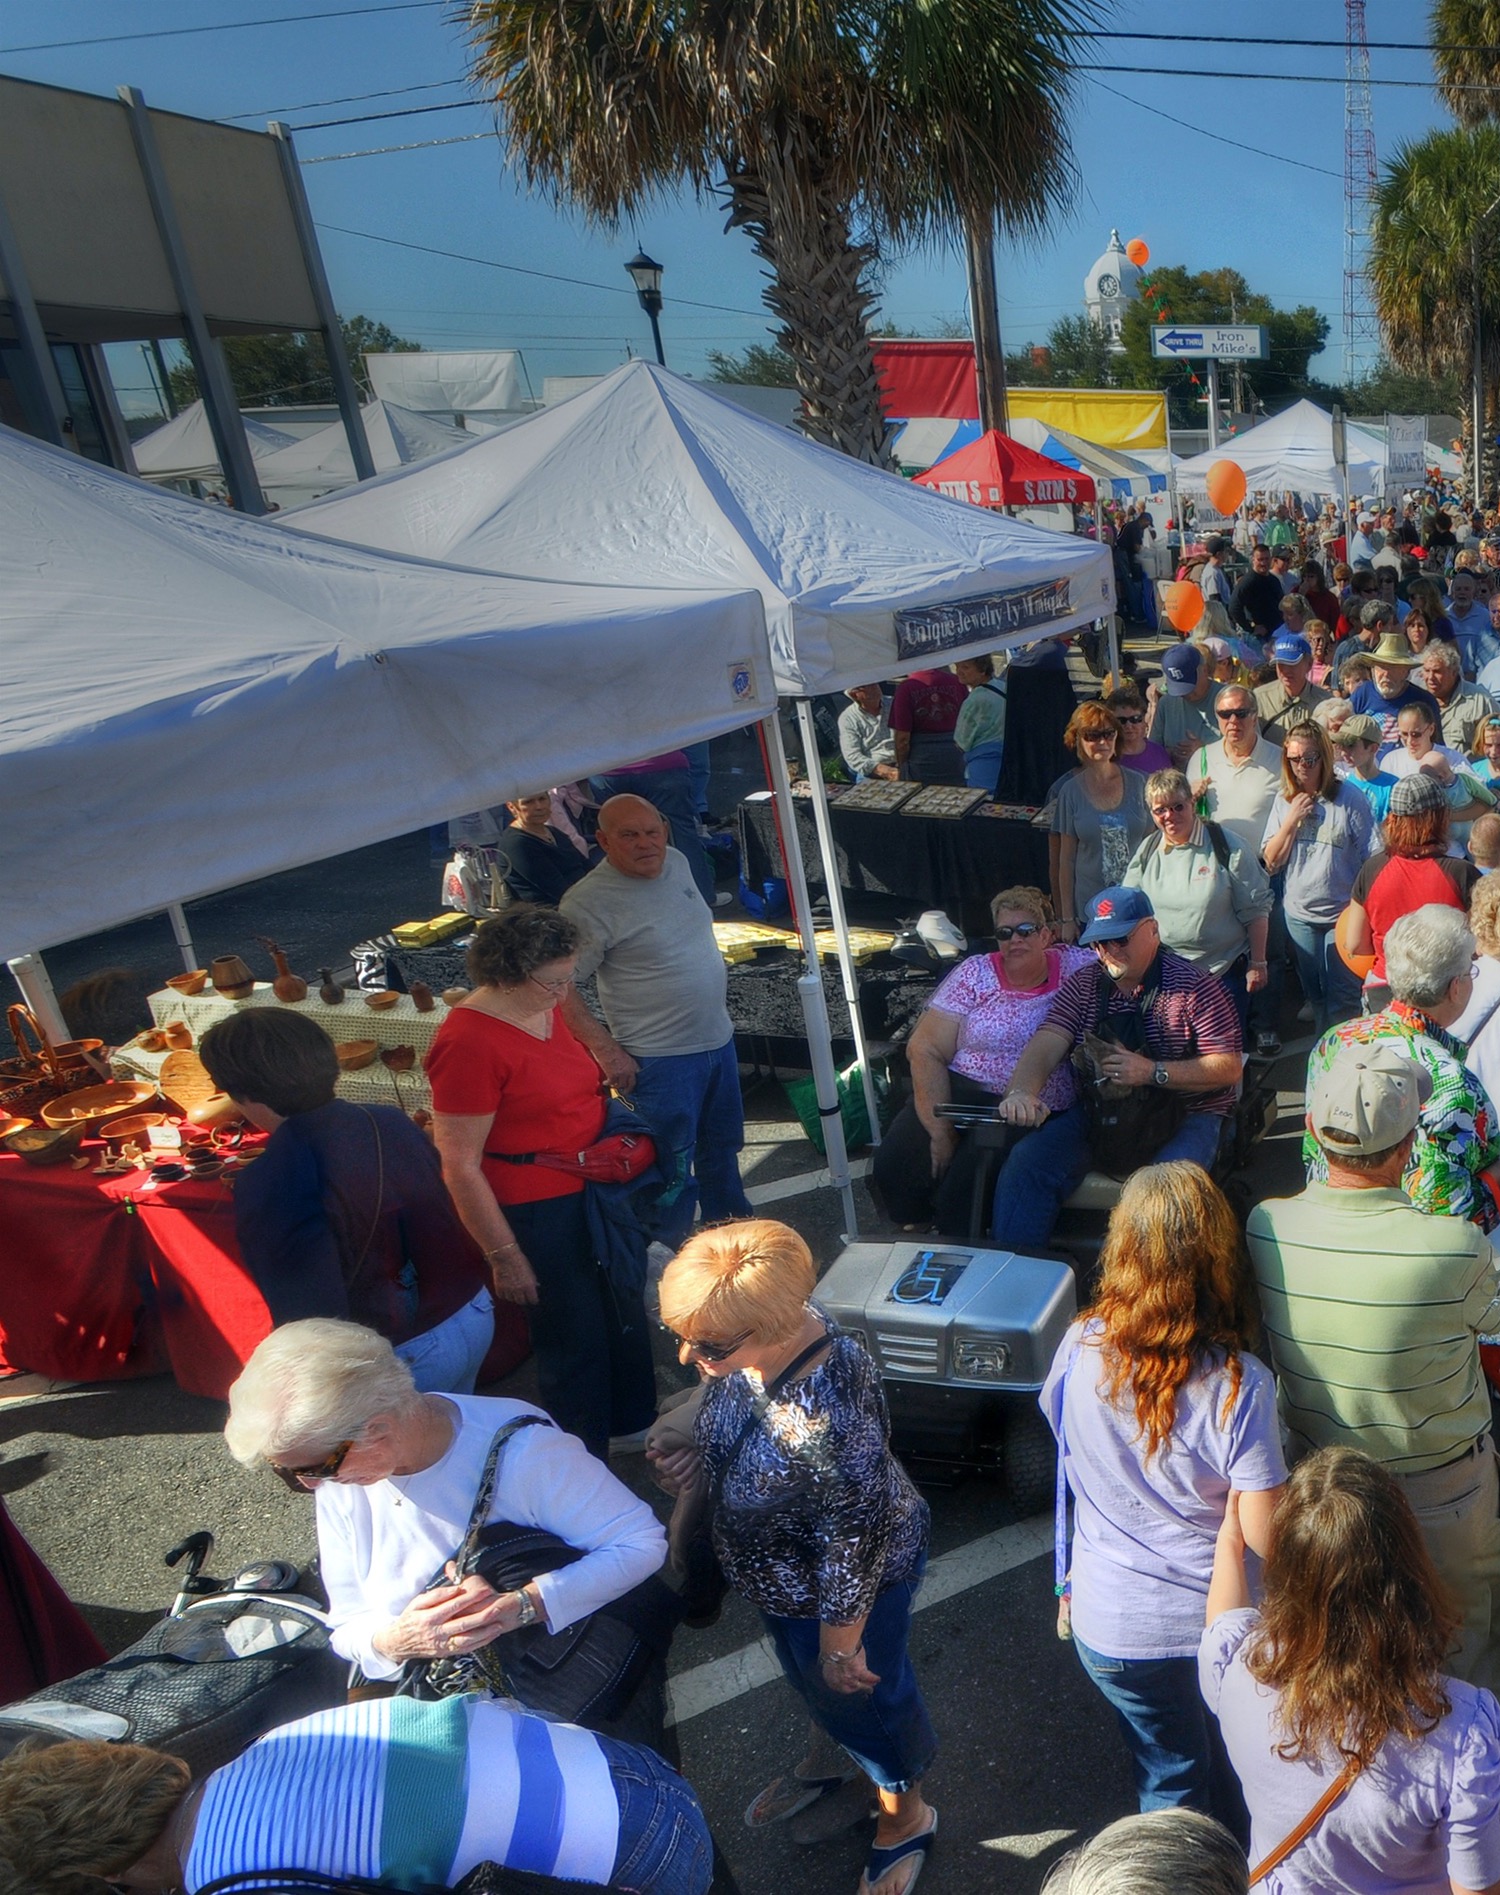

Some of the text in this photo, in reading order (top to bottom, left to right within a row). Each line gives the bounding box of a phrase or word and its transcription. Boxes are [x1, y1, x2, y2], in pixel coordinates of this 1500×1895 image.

[1216, 331, 1244, 341] Iron
[1164, 338, 1202, 346] DRIVE THRU
[1211, 343, 1256, 354] Mike's
[1036, 479, 1065, 501] ATM
[904, 612, 956, 646] Unique
[956, 604, 1001, 634] Jewelry
